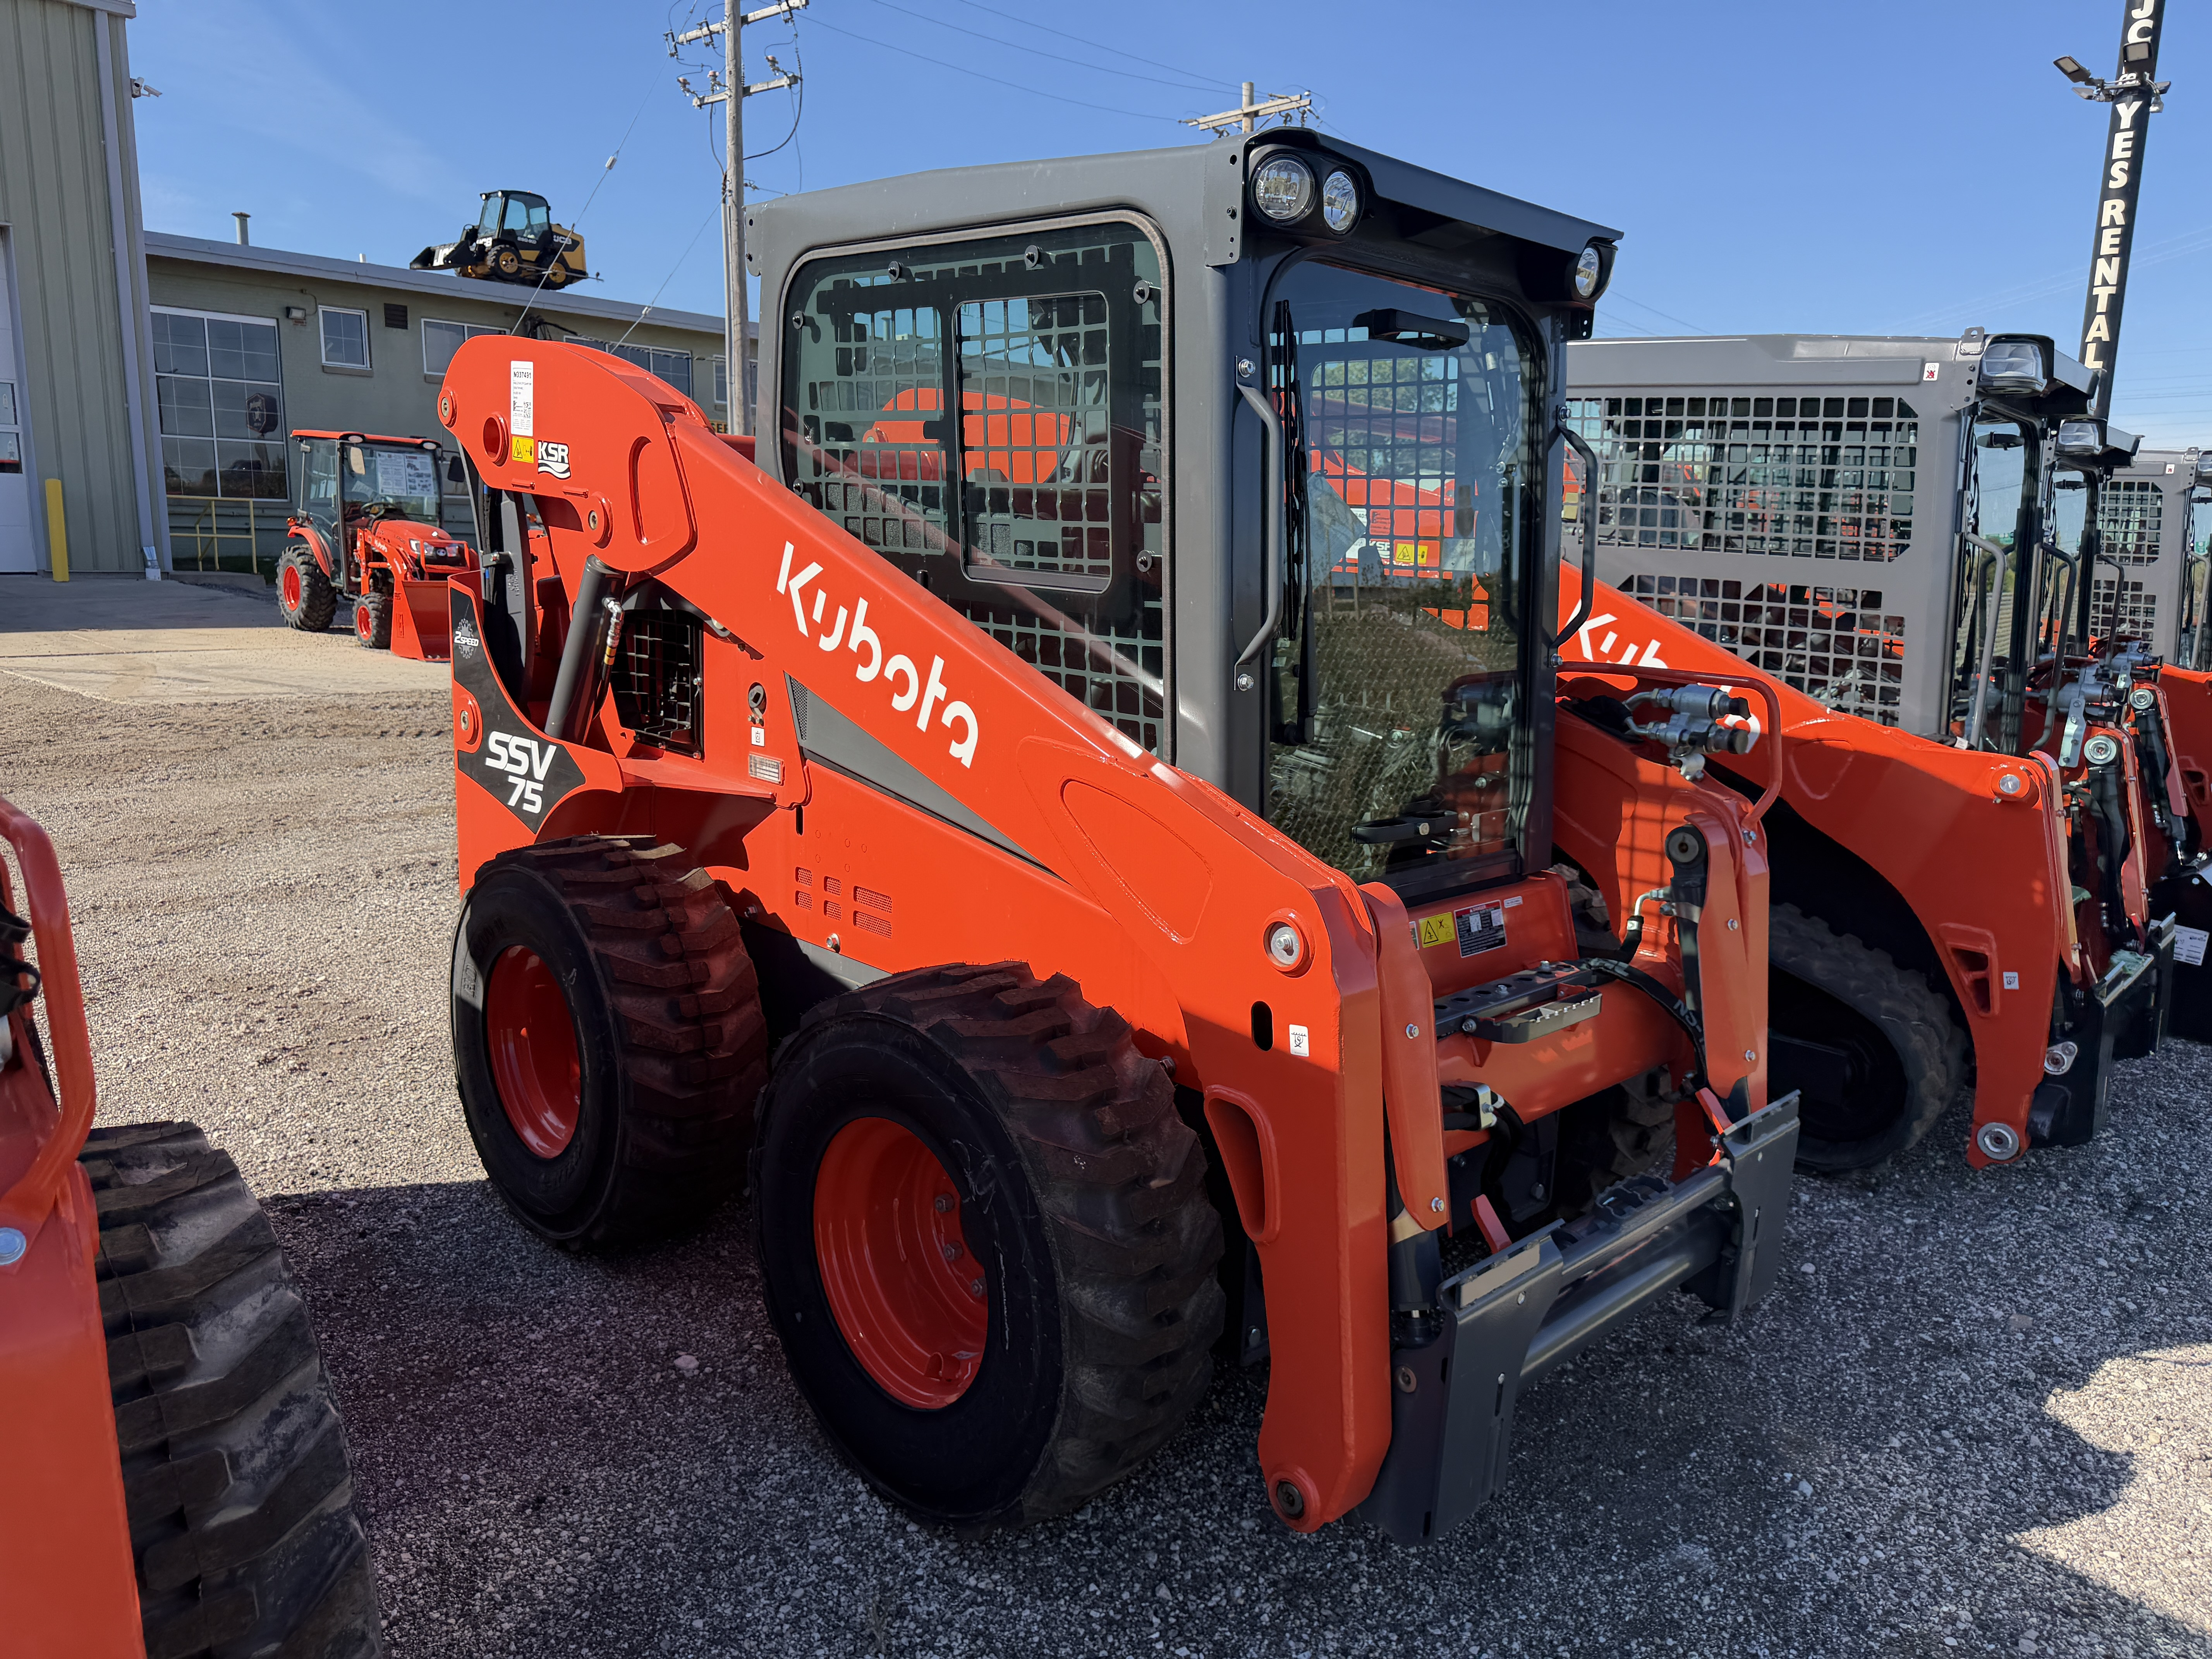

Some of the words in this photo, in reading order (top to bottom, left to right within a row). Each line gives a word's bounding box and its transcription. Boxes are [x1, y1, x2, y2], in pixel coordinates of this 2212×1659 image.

[2109, 101, 2143, 189] YES
[433, 247, 455, 266] JC
[2085, 199, 2126, 369] RENTAL
[538, 441, 568, 463] KSR
[776, 540, 978, 769] Kubota
[485, 731, 557, 781] SSV
[507, 775, 544, 814] 75
